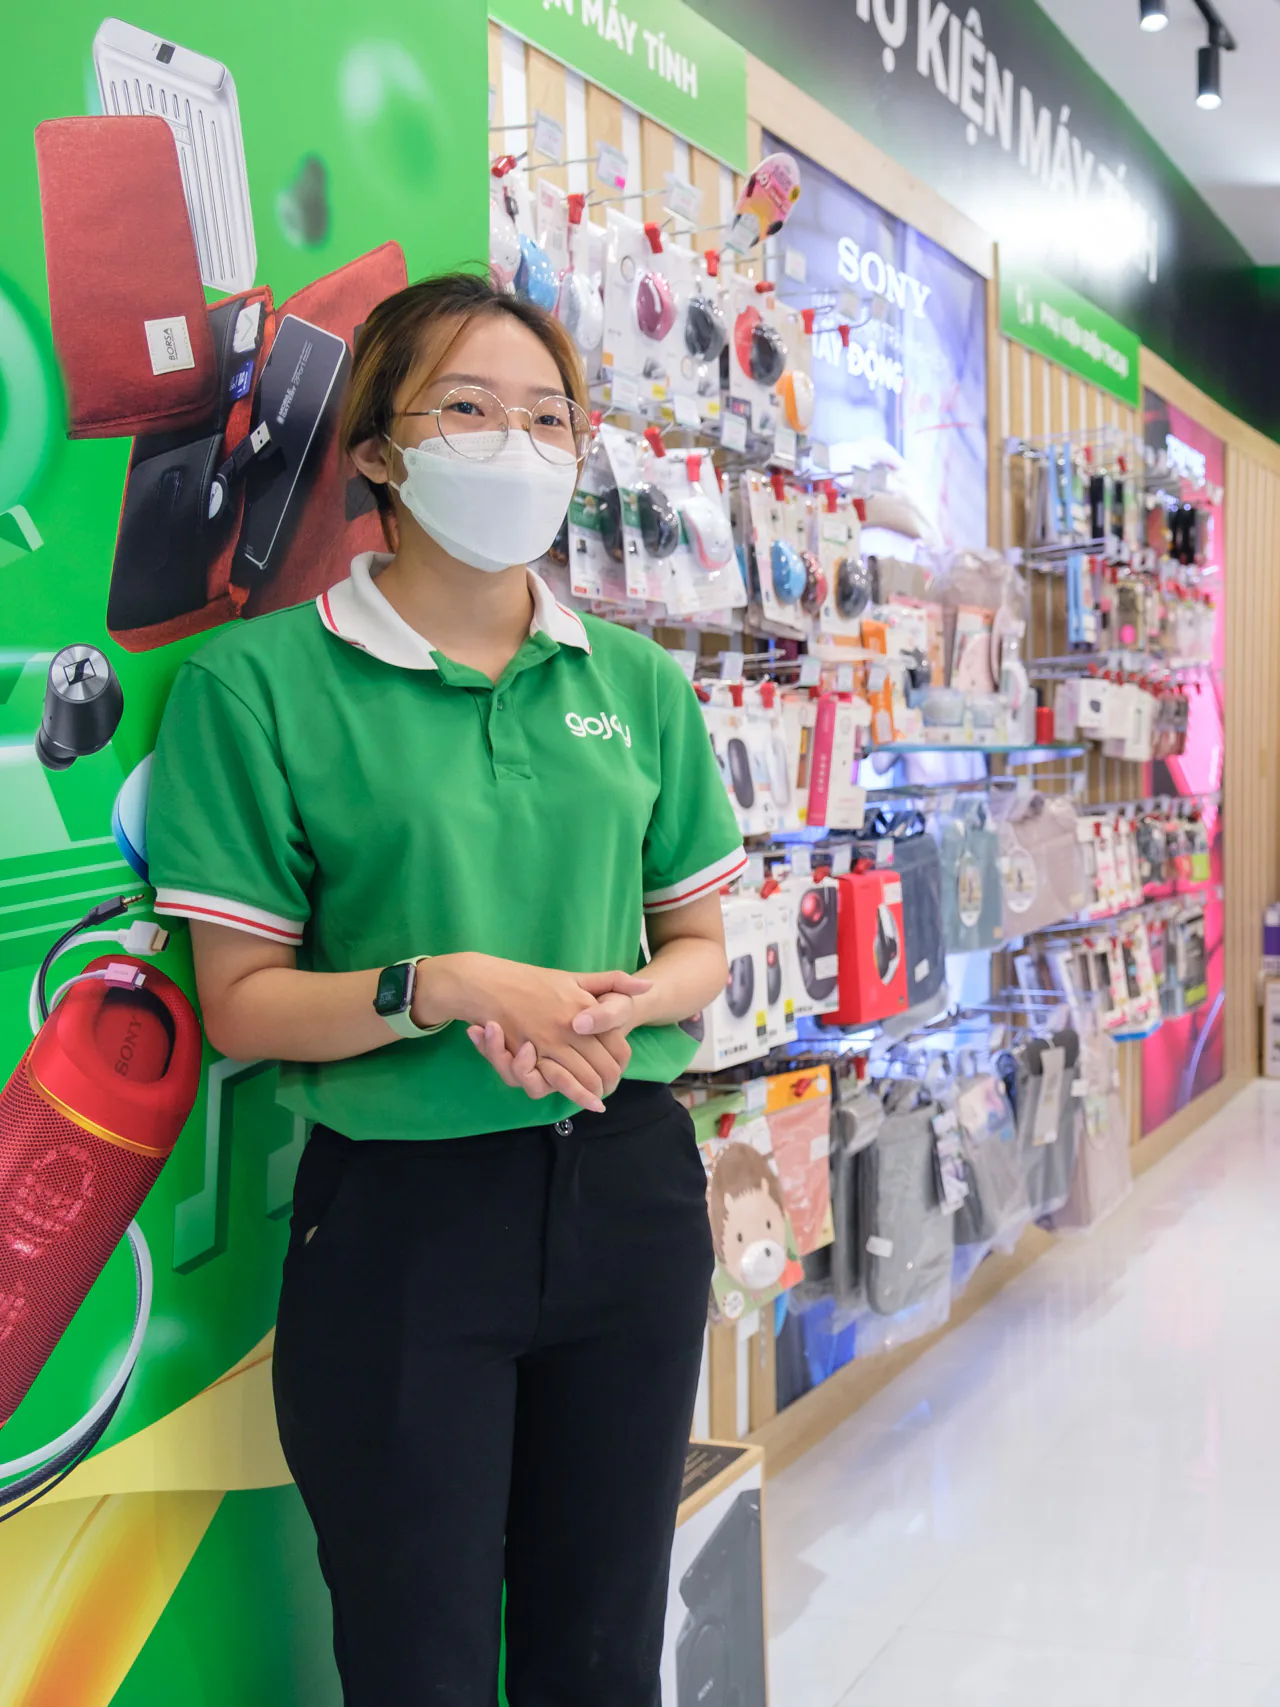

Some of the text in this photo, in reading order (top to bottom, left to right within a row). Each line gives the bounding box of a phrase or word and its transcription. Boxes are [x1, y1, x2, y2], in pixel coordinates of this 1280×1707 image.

[642, 28, 698, 100] TÍNH
[916, 0, 1014, 152] KIỆN
[837, 236, 931, 319] SONY
[163, 327, 176, 361] BORSA
[565, 711, 632, 748] gojoy
[114, 1014, 142, 1078] SONY
